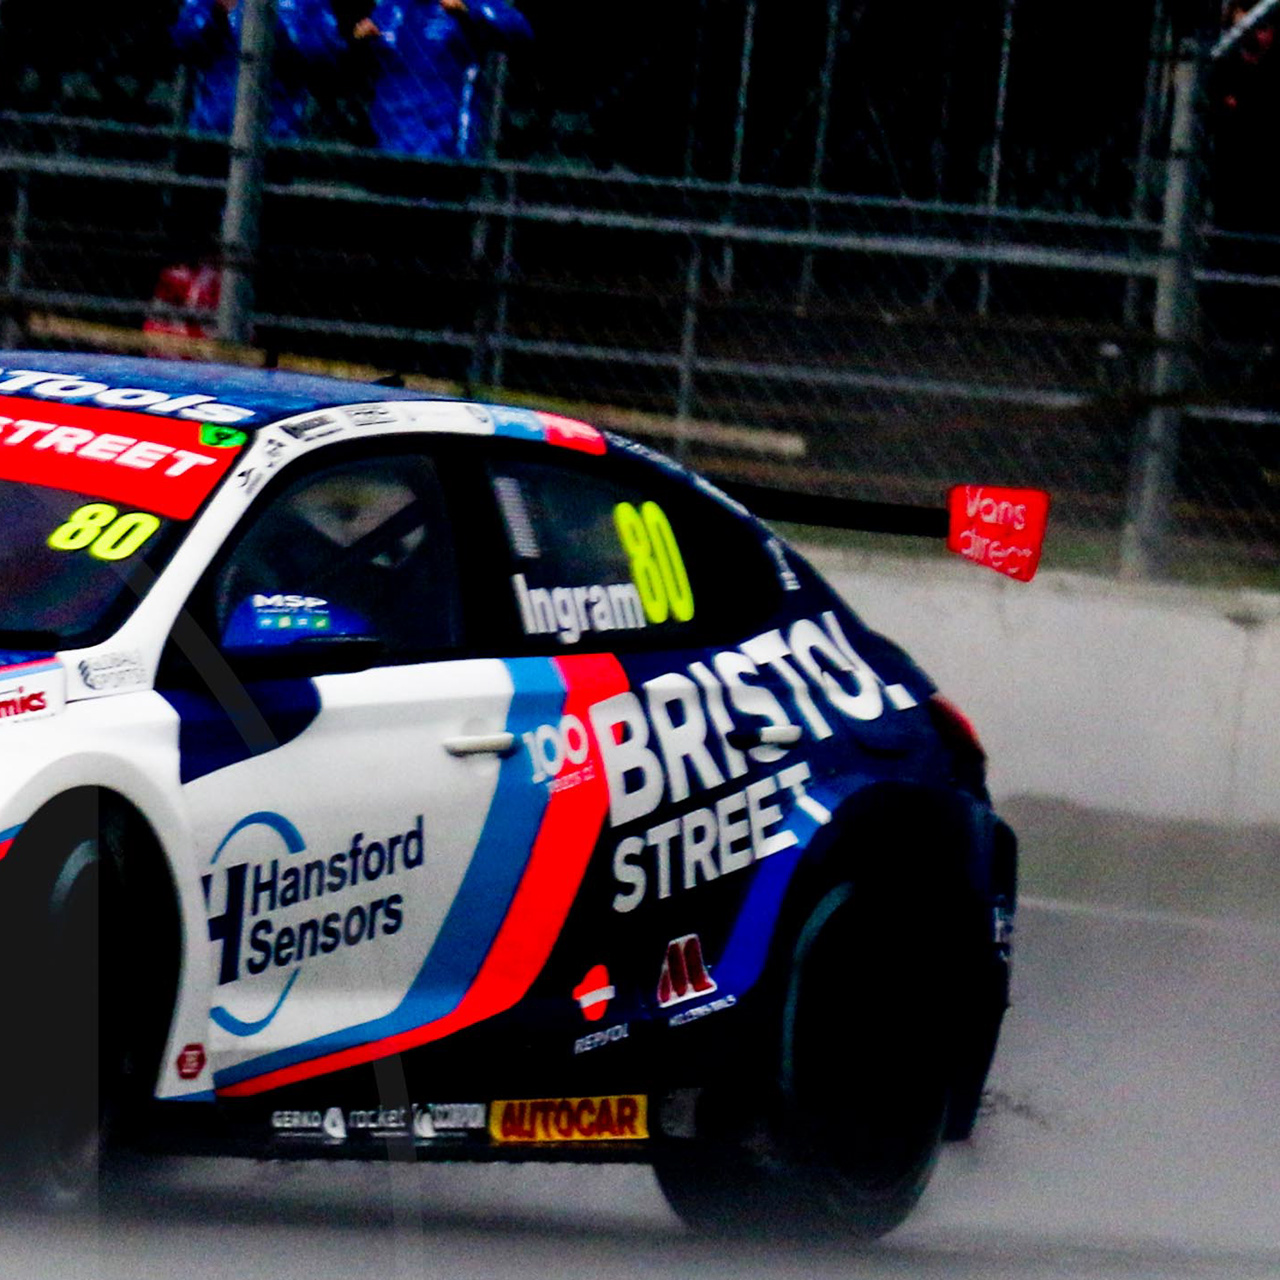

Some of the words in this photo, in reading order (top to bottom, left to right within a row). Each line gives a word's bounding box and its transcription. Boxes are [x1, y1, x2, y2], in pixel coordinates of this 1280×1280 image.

[47, 502, 161, 561] 80
[613, 501, 695, 624] 80
[511, 573, 647, 644] Ingram
[521, 713, 589, 784] 100
[251, 814, 424, 916] Hansford
[613, 762, 832, 914] STREET
[246, 893, 404, 975] Sensors
[502, 1098, 637, 1138] AUTOCAR
